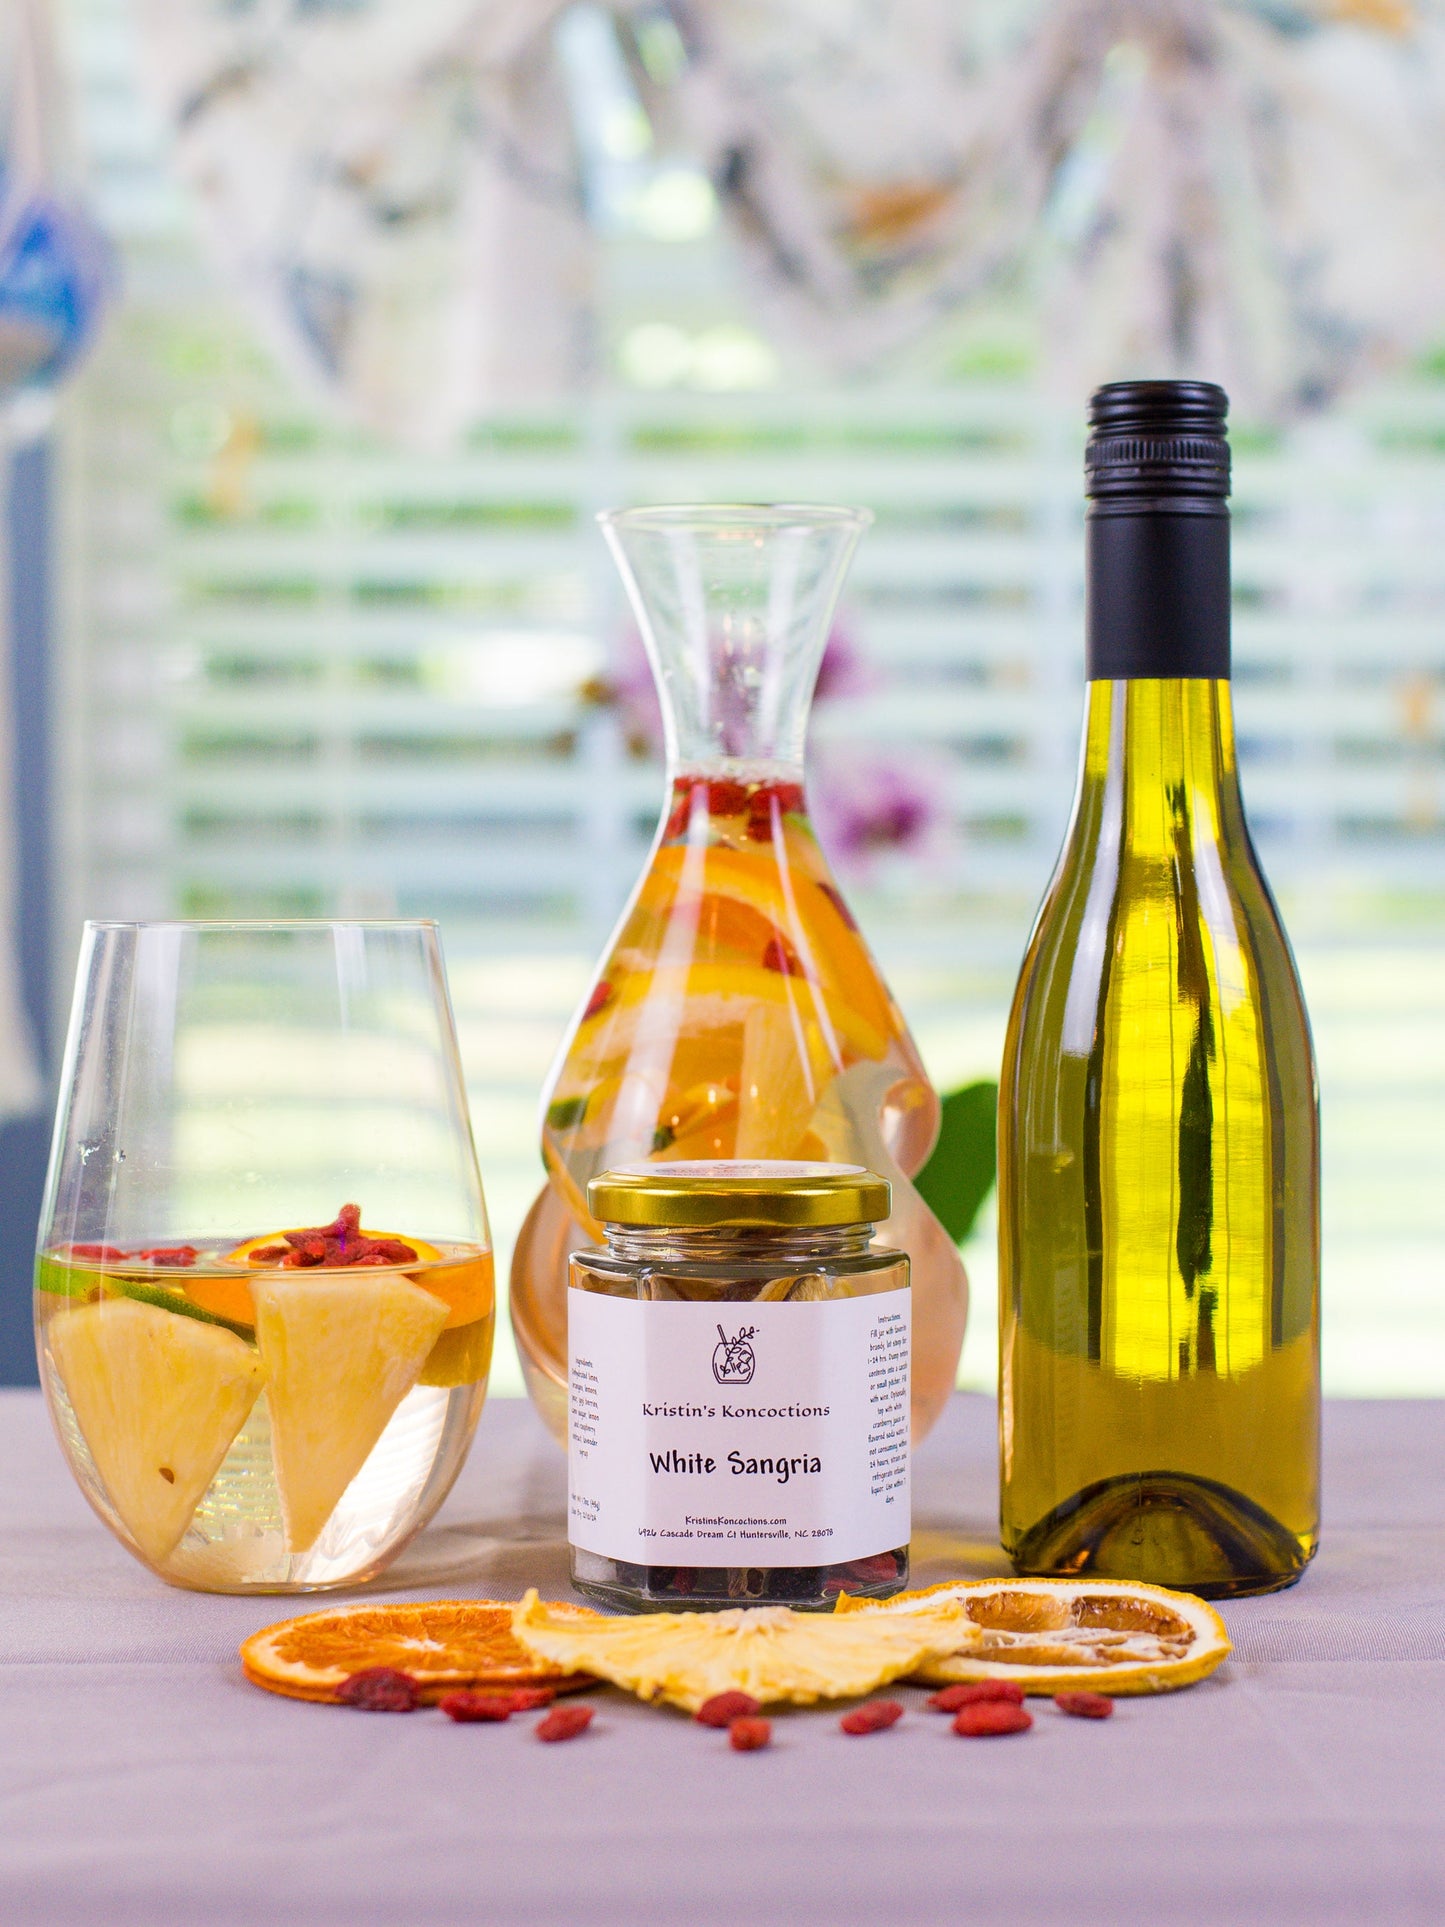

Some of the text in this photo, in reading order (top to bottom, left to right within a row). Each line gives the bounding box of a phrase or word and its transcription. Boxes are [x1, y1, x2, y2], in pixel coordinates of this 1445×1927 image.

[643, 1402, 831, 1418] Kristin's Koncoctions
[649, 1449, 822, 1484] White Sangria
[685, 1515, 787, 1526] KristinsKoncoctions.com
[638, 1527, 833, 1540] 6926 Cascade Dream Ct Huntersville, NC 28078
